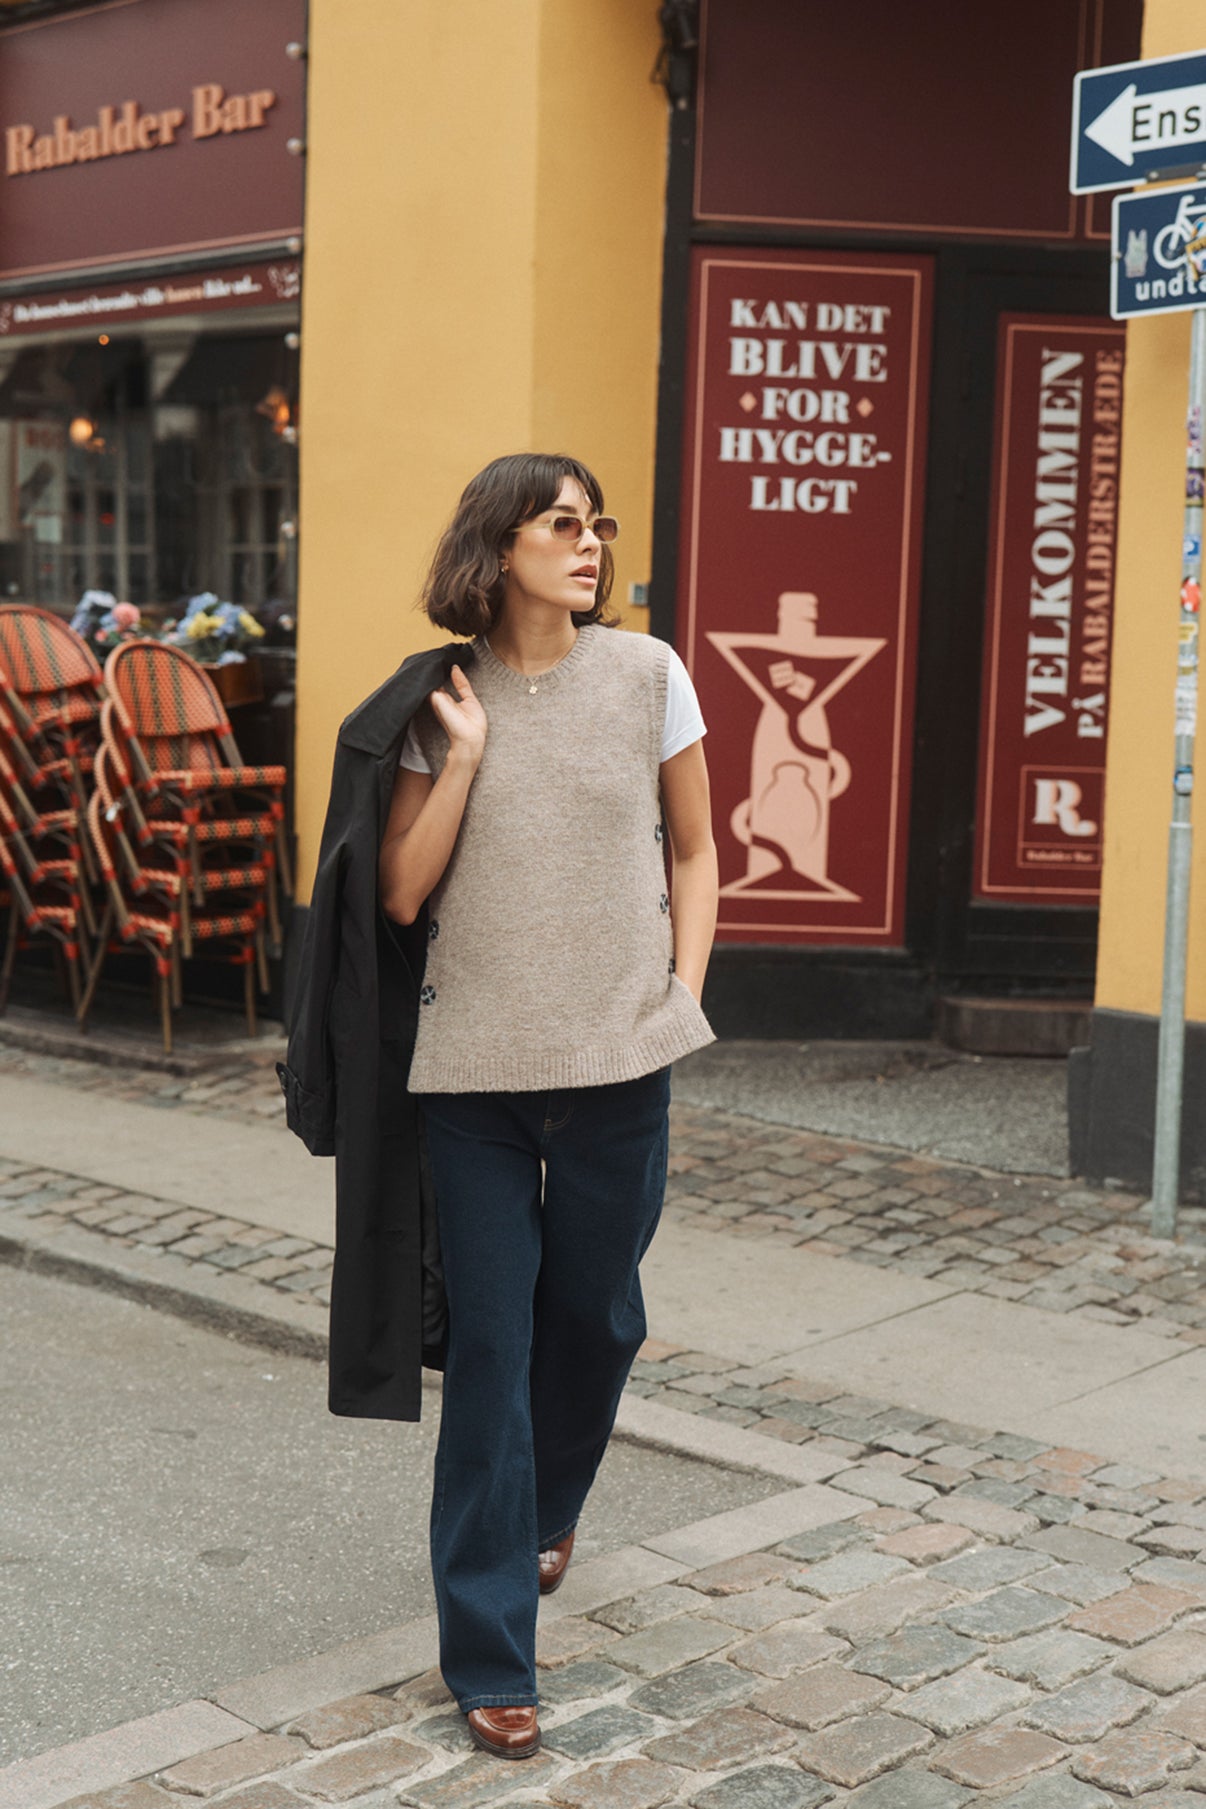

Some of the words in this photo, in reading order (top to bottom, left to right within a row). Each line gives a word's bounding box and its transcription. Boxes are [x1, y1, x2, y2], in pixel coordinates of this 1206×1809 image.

[5, 101, 185, 176] Rabalder
[192, 83, 276, 140] Bar
[1132, 104, 1201, 142] Ens
[730, 299, 808, 330] KAN
[816, 303, 891, 334] DET
[729, 337, 888, 382] BLIVE
[761, 387, 850, 424] FOR
[719, 427, 892, 467] HYGGE-
[749, 475, 858, 514] LIGT
[1080, 351, 1122, 684] RABALDERSTRÆDE
[1024, 347, 1084, 738] VELKOMMEN
[1071, 693, 1105, 737] PÅ
[1033, 778, 1098, 837] R
